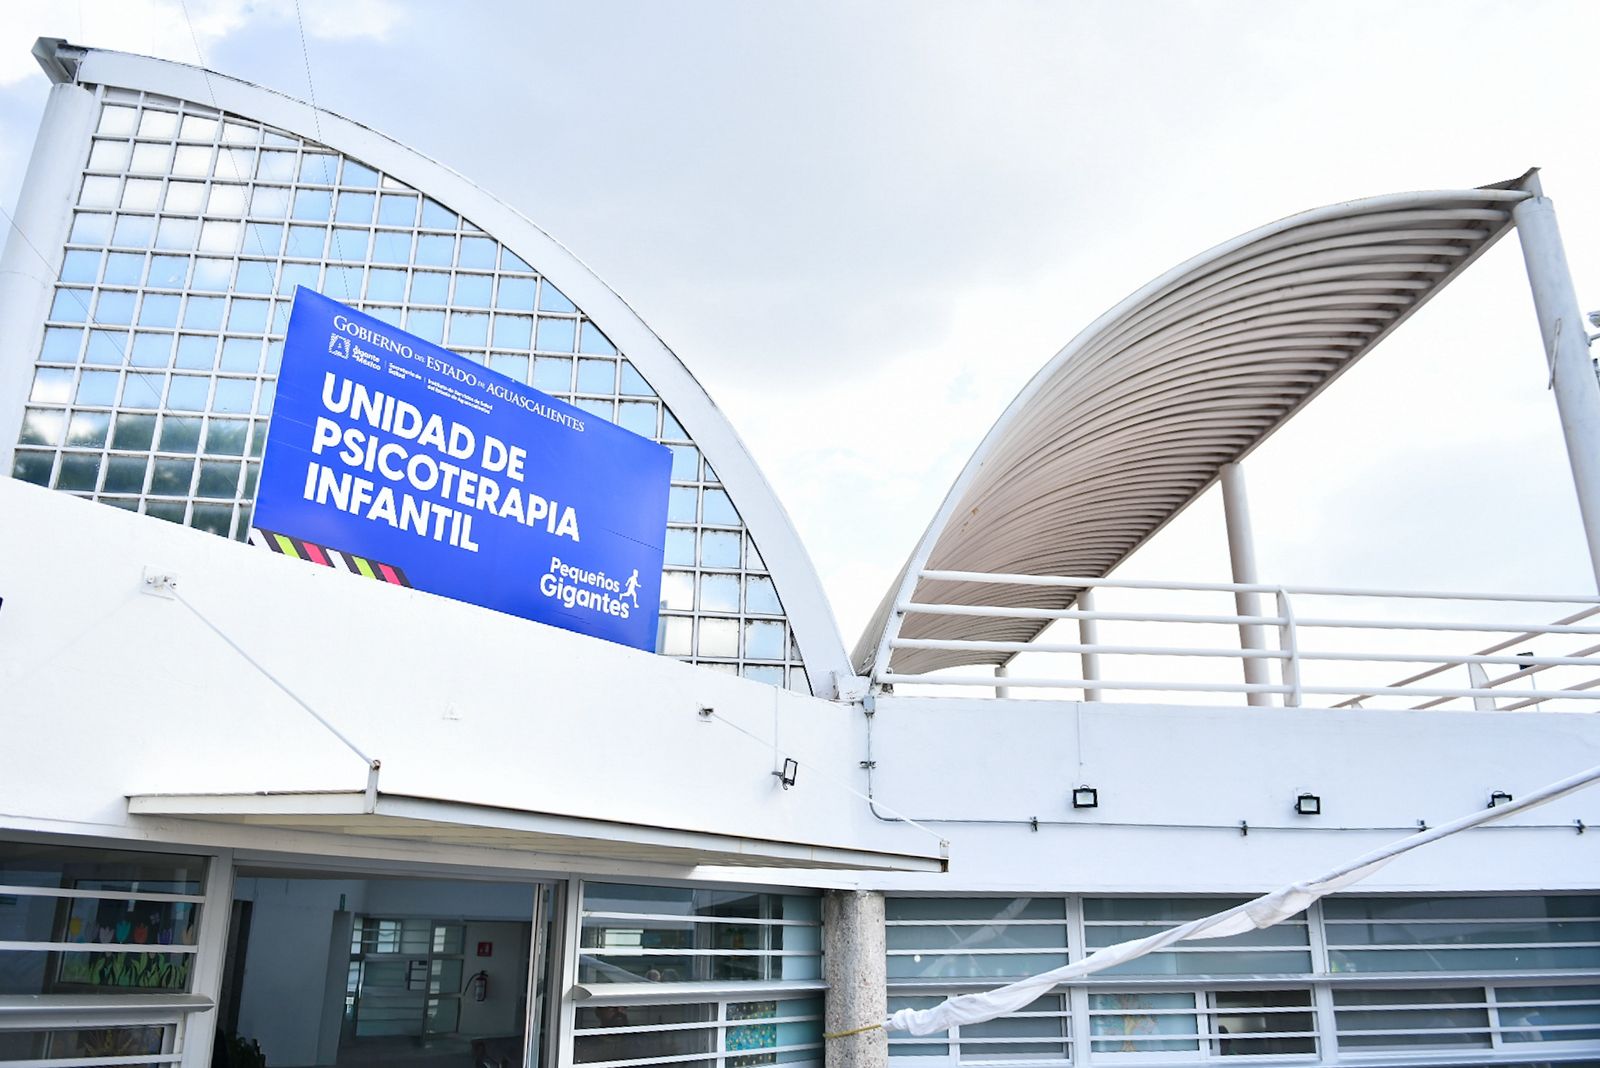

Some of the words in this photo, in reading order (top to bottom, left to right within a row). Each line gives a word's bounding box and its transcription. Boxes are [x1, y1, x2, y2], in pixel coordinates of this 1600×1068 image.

[333, 315, 413, 359] GOBIERNO
[426, 355, 477, 387] ESTADO
[486, 383, 585, 432] AGUASCALIENTES
[322, 371, 476, 459] UNIDAD
[481, 434, 527, 483] DE
[303, 461, 479, 552] INFANTIL
[312, 416, 580, 542] PSICOTERAPIA
[540, 573, 630, 619] Gigantes
[550, 556, 620, 593] Pequeños
